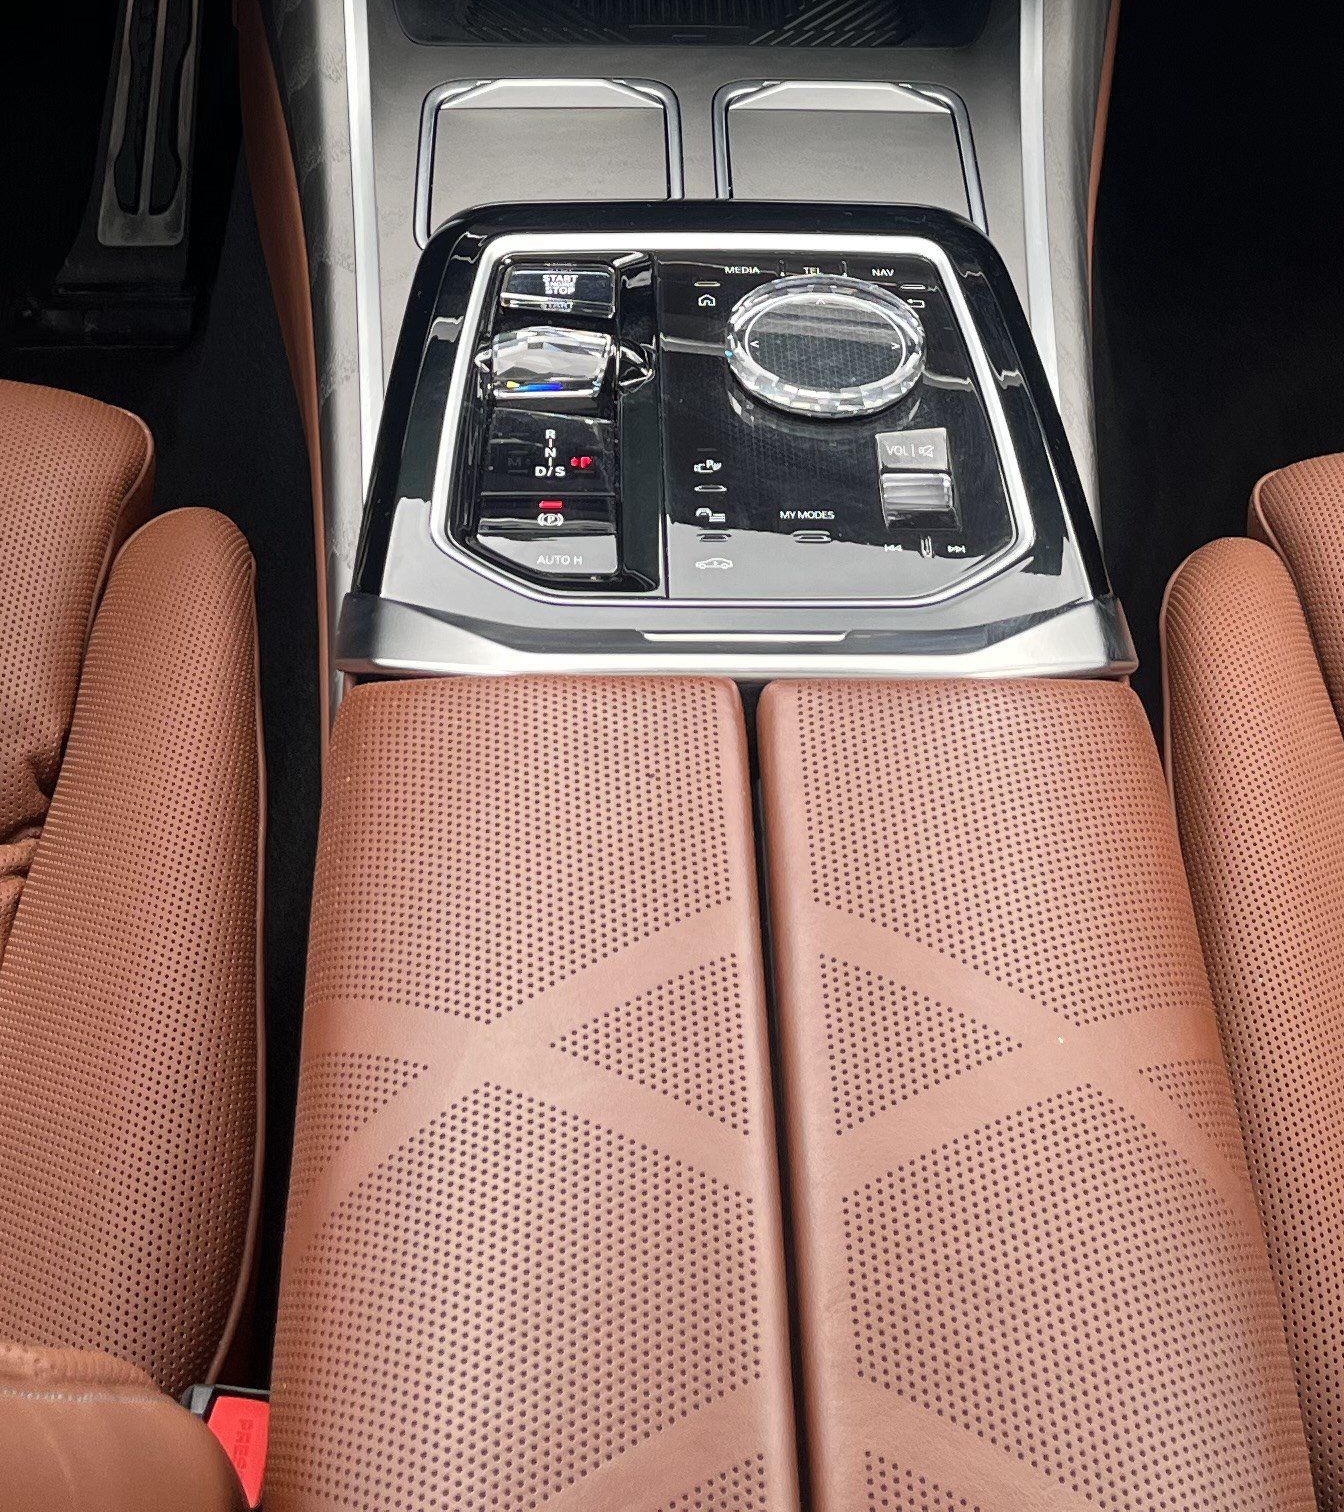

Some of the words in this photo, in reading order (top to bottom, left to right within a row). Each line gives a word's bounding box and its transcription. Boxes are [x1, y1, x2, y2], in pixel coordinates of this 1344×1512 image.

[725, 266, 761, 275] MEDIA
[871, 268, 895, 277] NAV
[542, 274, 579, 282] START
[545, 287, 576, 295] STOP
[545, 429, 556, 439] R
[544, 447, 557, 458] N
[885, 443, 908, 457] VOL
[779, 510, 796, 520] MY
[797, 510, 835, 521] MODES
[536, 554, 571, 566] AUTO
[573, 555, 583, 565] H
